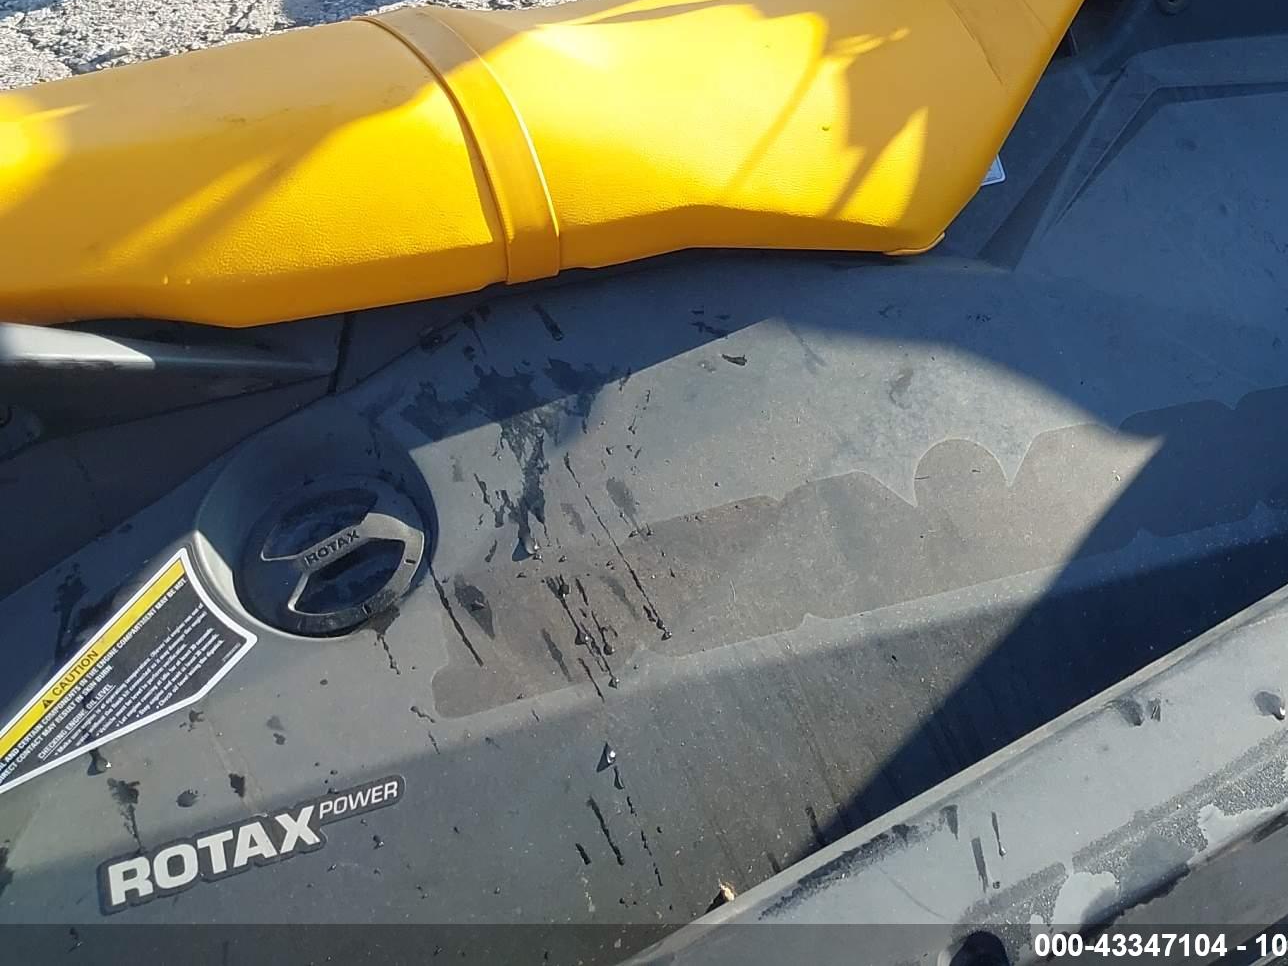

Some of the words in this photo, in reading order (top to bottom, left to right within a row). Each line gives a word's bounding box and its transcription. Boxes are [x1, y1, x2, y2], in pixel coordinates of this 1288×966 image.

[304, 529, 360, 566] ROTAX
[5, 748, 19, 762] AND
[17, 723, 43, 749] CERTAIN
[41, 685, 81, 724] COMPONENTS
[86, 667, 99, 679] THE
[96, 647, 118, 669] ENGINE
[117, 608, 156, 648] COMPARTMENT
[52, 650, 99, 696] CAUTION
[16, 735, 43, 762] CONTACT
[42, 722, 56, 736] MAY
[55, 701, 76, 723] RESULT
[82, 681, 97, 695] SKIN
[38, 730, 67, 758] CHECKING
[86, 700, 97, 709] OIL
[95, 684, 113, 700] LEVEL
[108, 806, 320, 906] ROTAX
[319, 781, 398, 819] POWER
